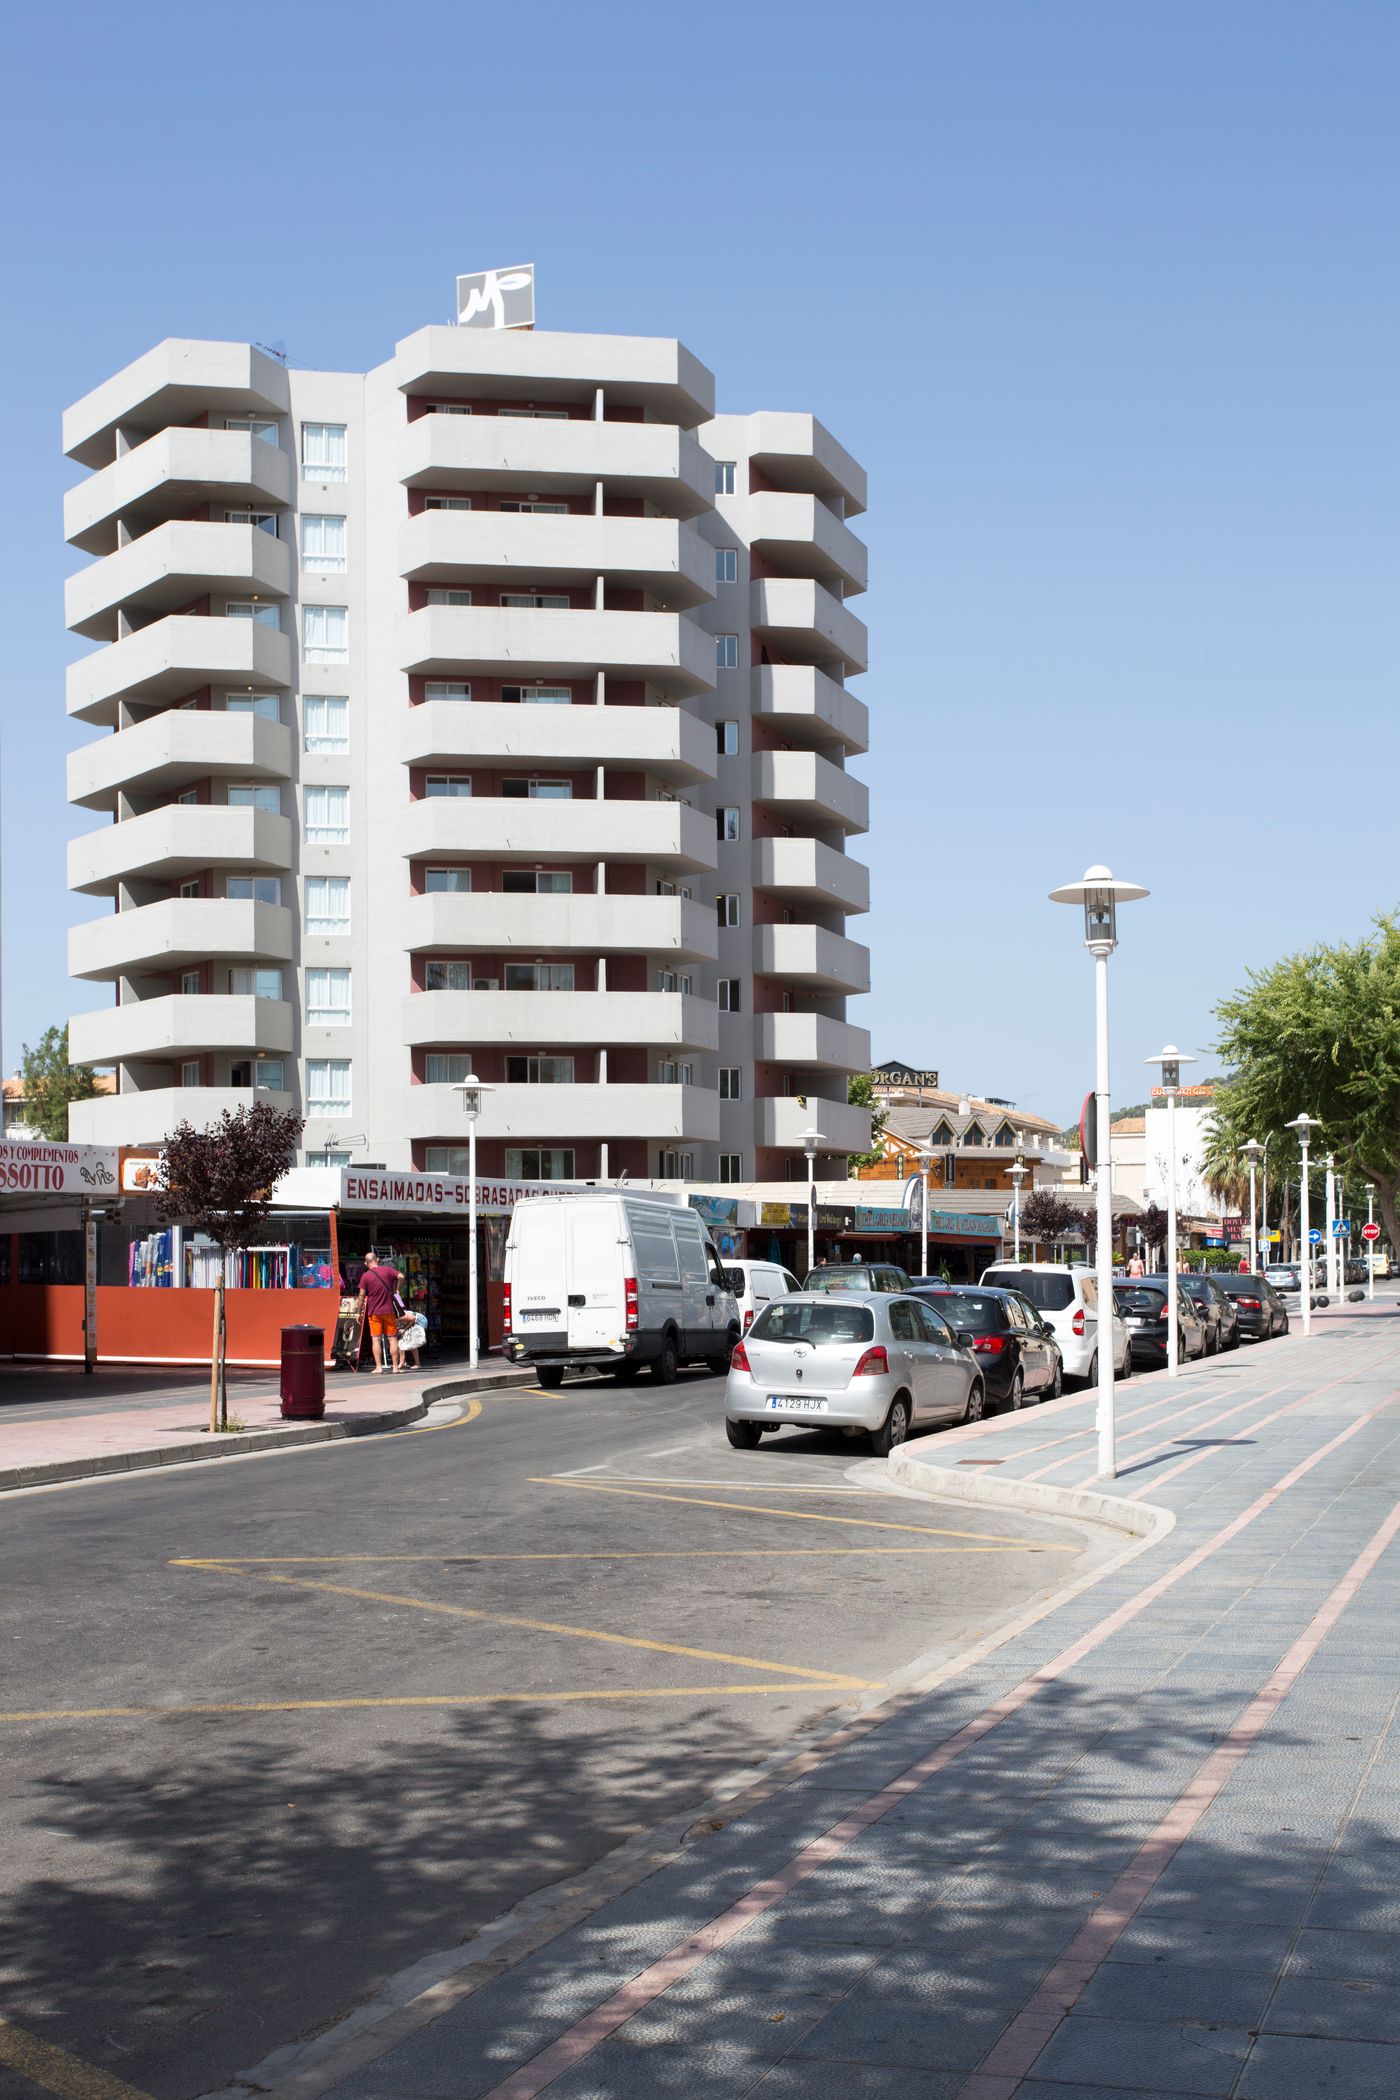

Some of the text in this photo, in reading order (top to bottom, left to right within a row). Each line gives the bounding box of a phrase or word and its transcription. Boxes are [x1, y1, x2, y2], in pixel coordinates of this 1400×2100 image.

[10, 1146, 16, 1160] Y
[16, 1146, 79, 1164] COMPLEMENTOS
[778, 1399, 822, 1410] 4129 HJX
